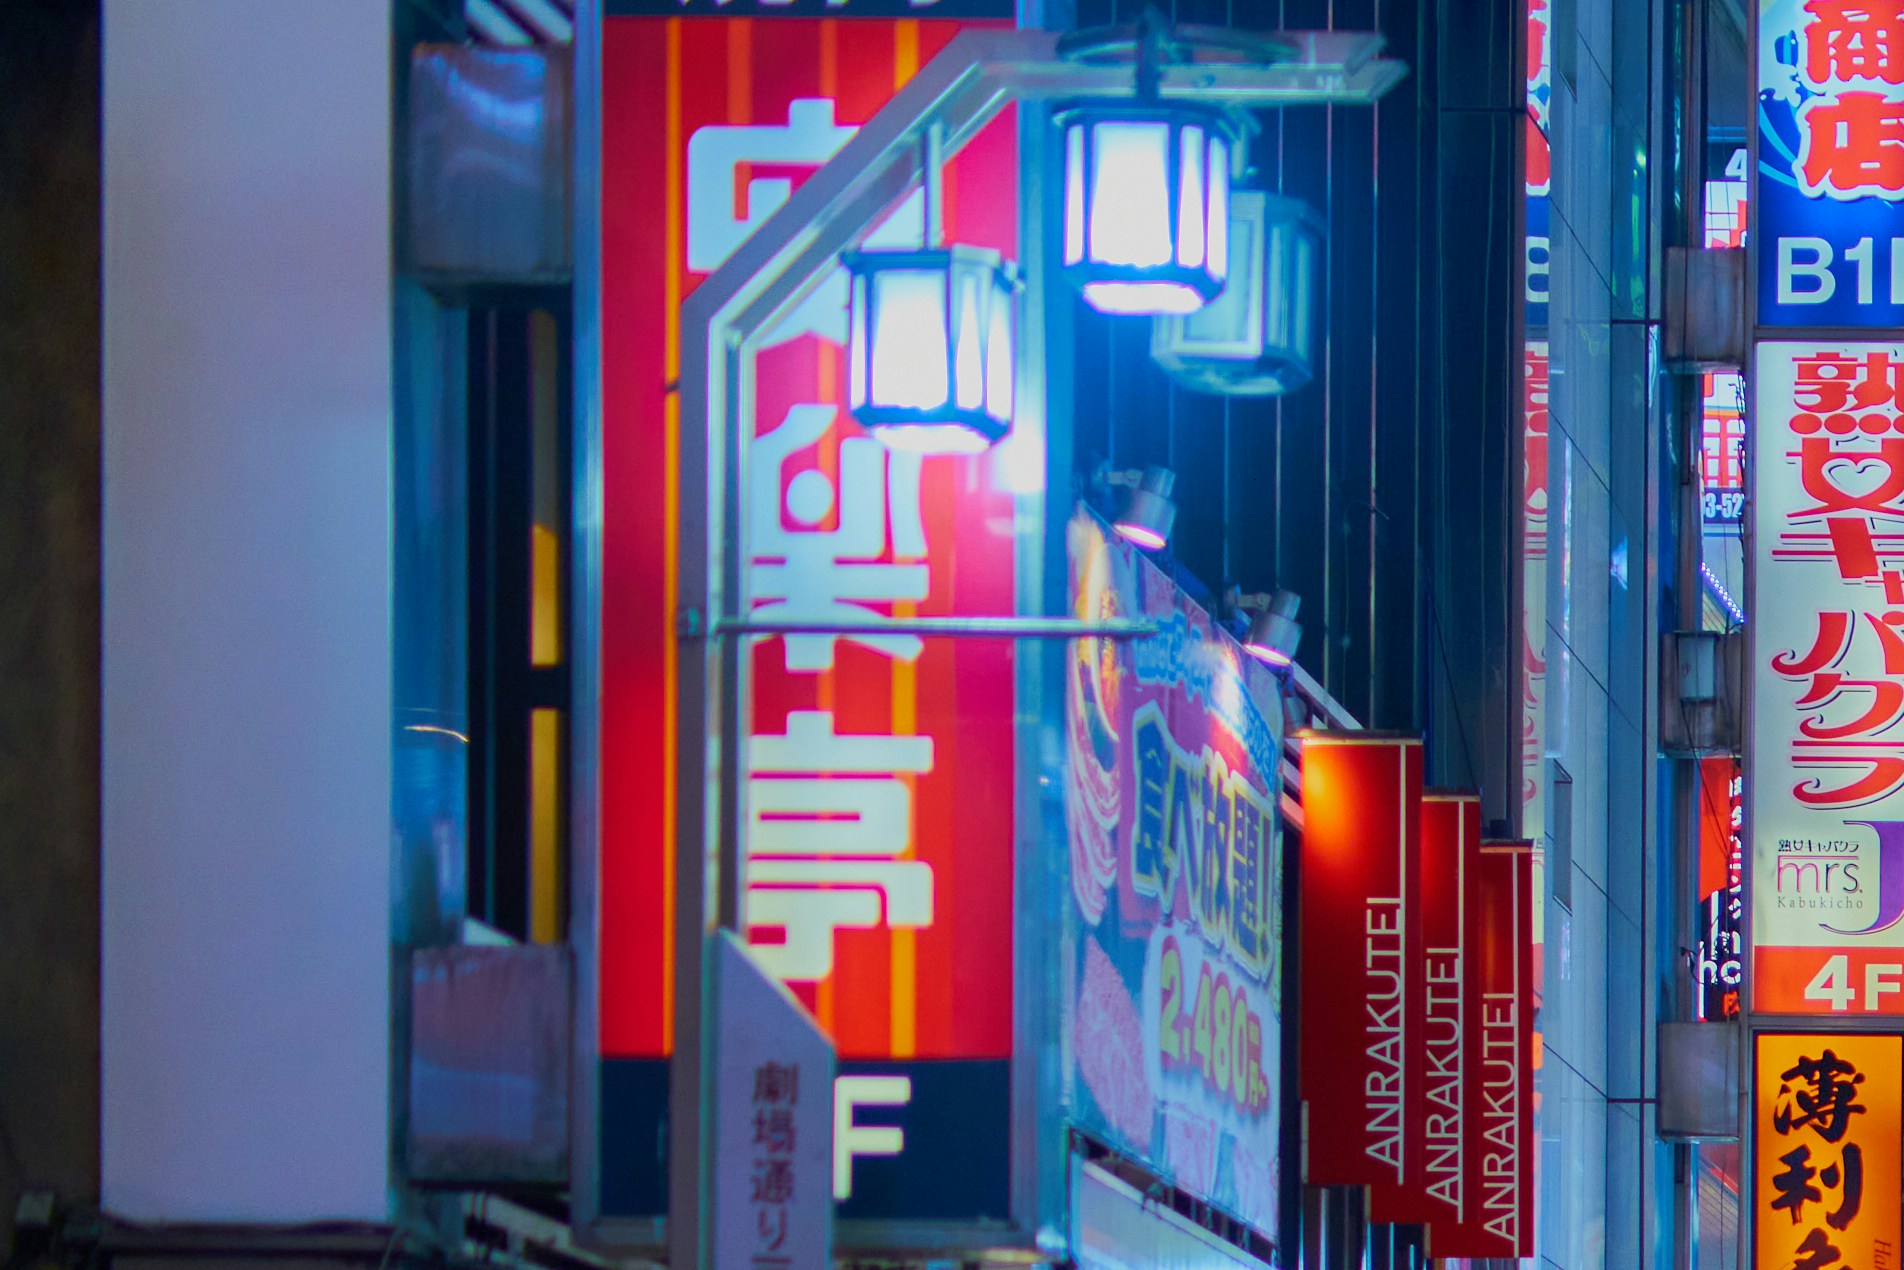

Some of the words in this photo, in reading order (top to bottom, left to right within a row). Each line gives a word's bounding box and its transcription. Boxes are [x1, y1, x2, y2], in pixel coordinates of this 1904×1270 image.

[1777, 895, 1863, 910] Kabukicho
[1778, 839, 1859, 853] 熟女キャバクラ
[1365, 896, 1400, 1167] ANRAKUTEI
[1804, 954, 1903, 1010] 4F
[1426, 946, 1458, 1208] ANRAKUTEI
[1484, 992, 1515, 1242] ANRAKUTEI
